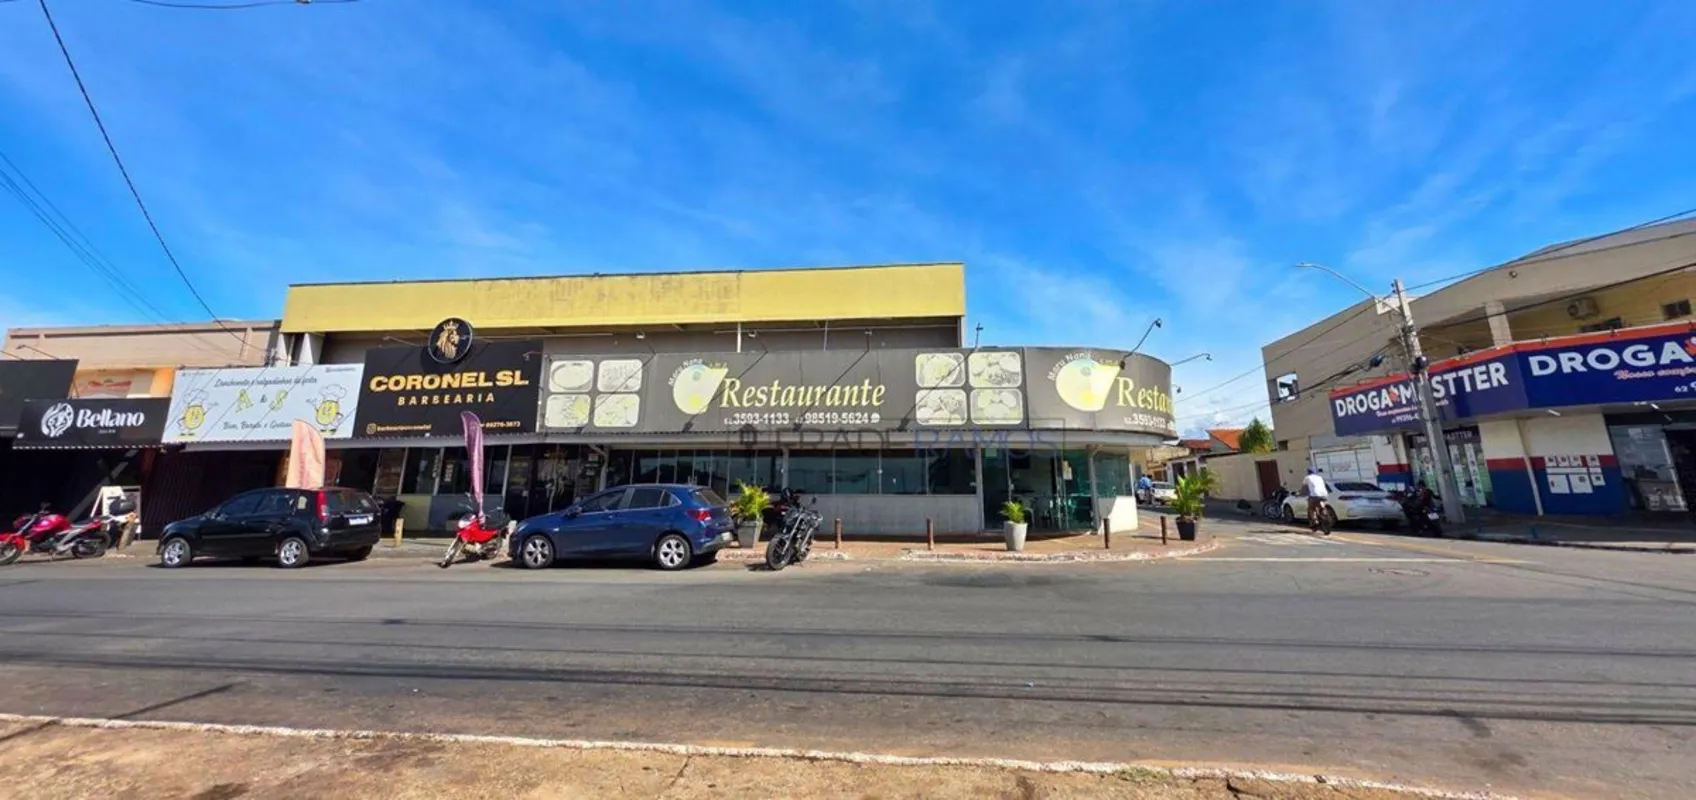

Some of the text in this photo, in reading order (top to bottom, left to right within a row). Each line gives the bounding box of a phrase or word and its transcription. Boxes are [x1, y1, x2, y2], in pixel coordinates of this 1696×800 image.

[1528, 341, 1694, 376] DROGA
[369, 370, 529, 392] CORONEL SL
[719, 377, 886, 408] Restaurante
[1336, 362, 1509, 417] DROGA MSTTER
[397, 393, 495, 406] BARBEARIA
[76, 408, 145, 428] Bellano
